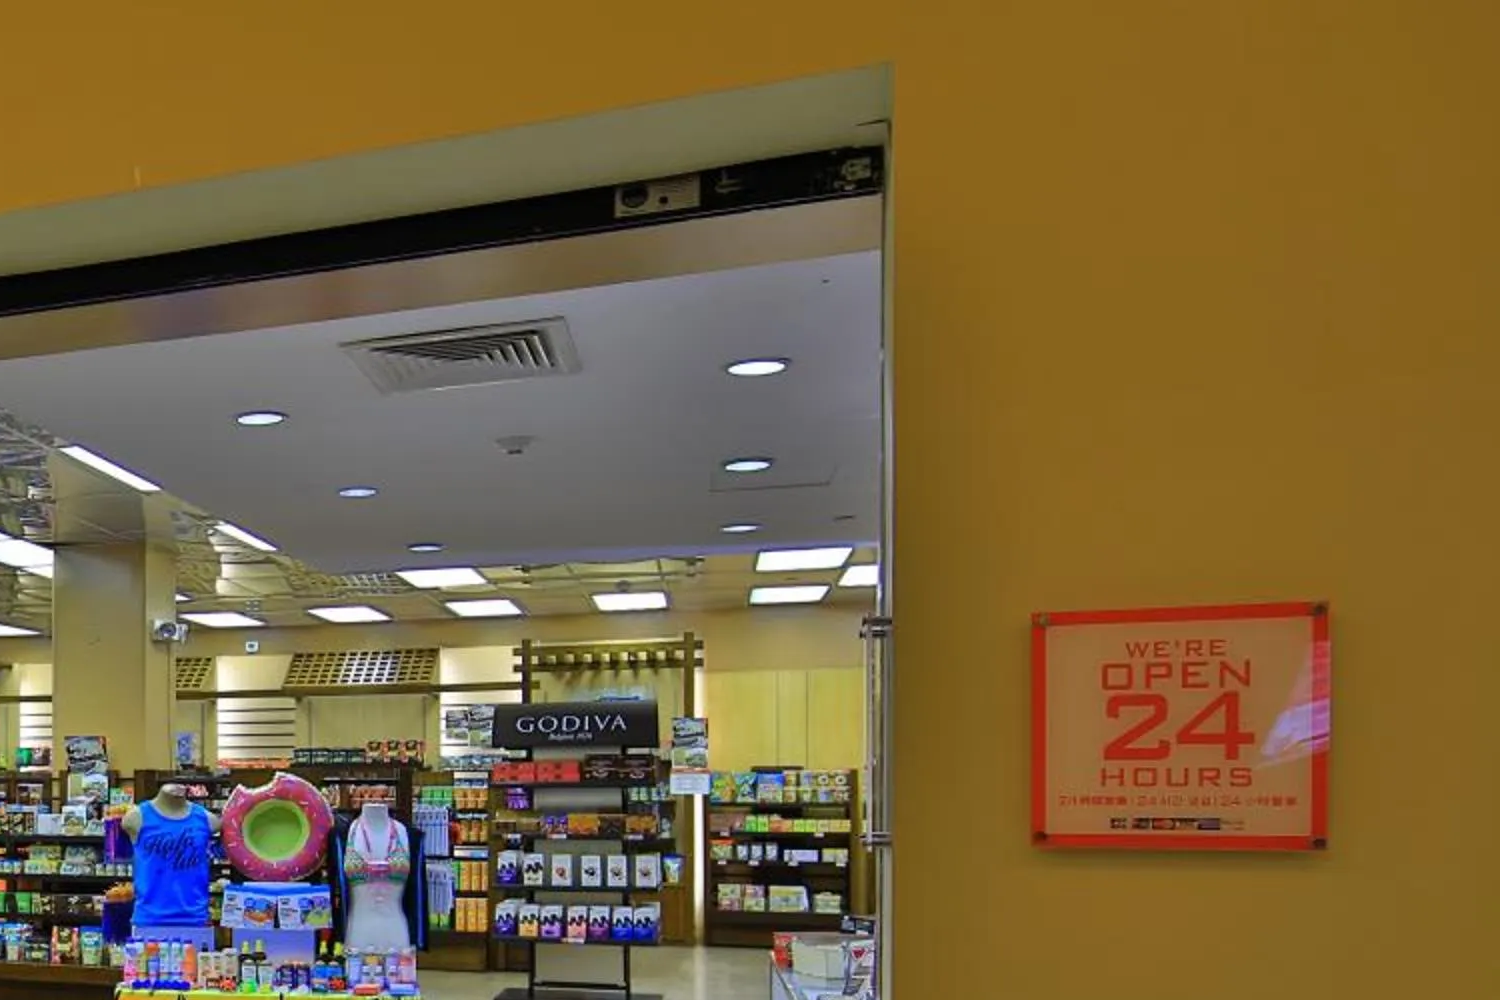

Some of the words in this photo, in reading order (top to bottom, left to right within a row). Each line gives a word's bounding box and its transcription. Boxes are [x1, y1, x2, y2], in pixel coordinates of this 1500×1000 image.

[1125, 639, 1227, 658] WE'RE
[1102, 659, 1250, 690] OPEN
[516, 714, 627, 733] GODIVA
[1103, 691, 1255, 760] 24
[1101, 767, 1252, 787] HOURS
